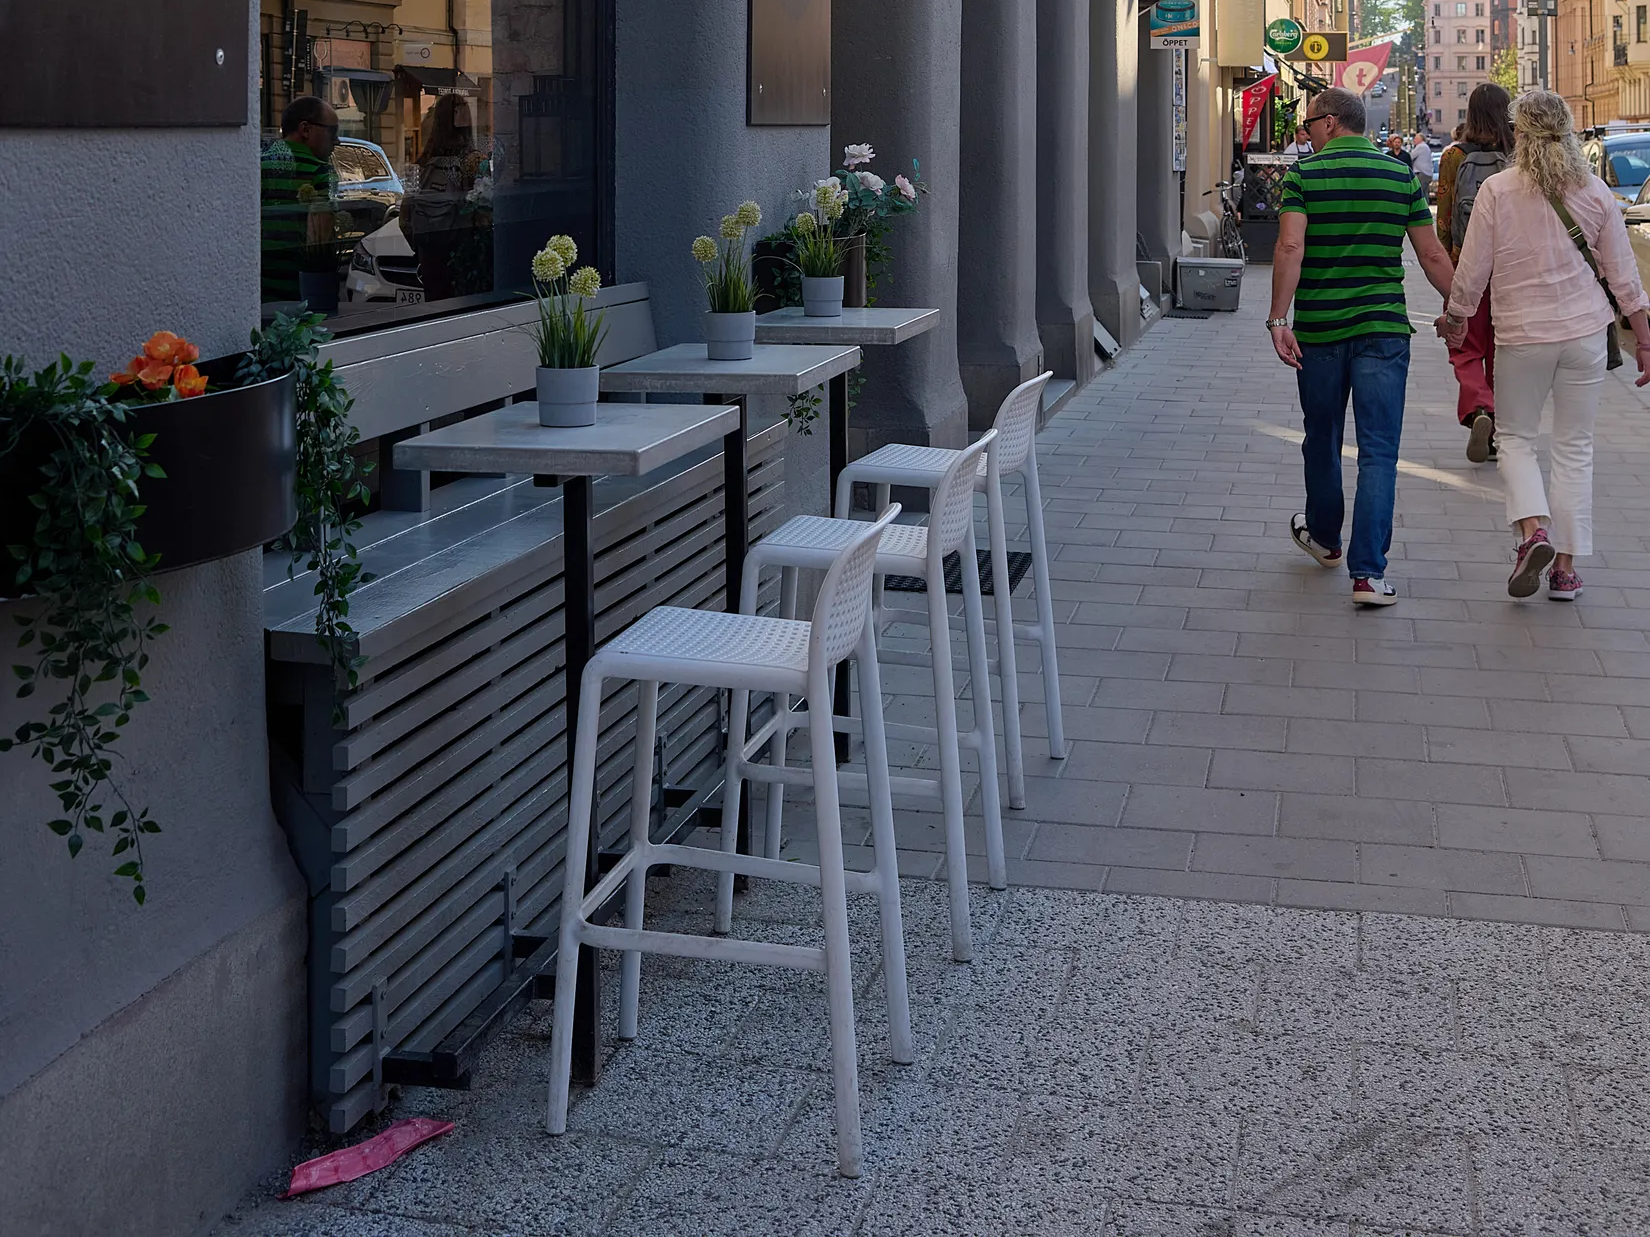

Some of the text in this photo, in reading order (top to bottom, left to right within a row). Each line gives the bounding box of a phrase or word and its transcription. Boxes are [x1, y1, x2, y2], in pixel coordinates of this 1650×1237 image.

[1269, 28, 1298, 40] Carlsberg
[1162, 38, 1188, 46] ÖPPET
[1245, 85, 1267, 135] ÖPPET
